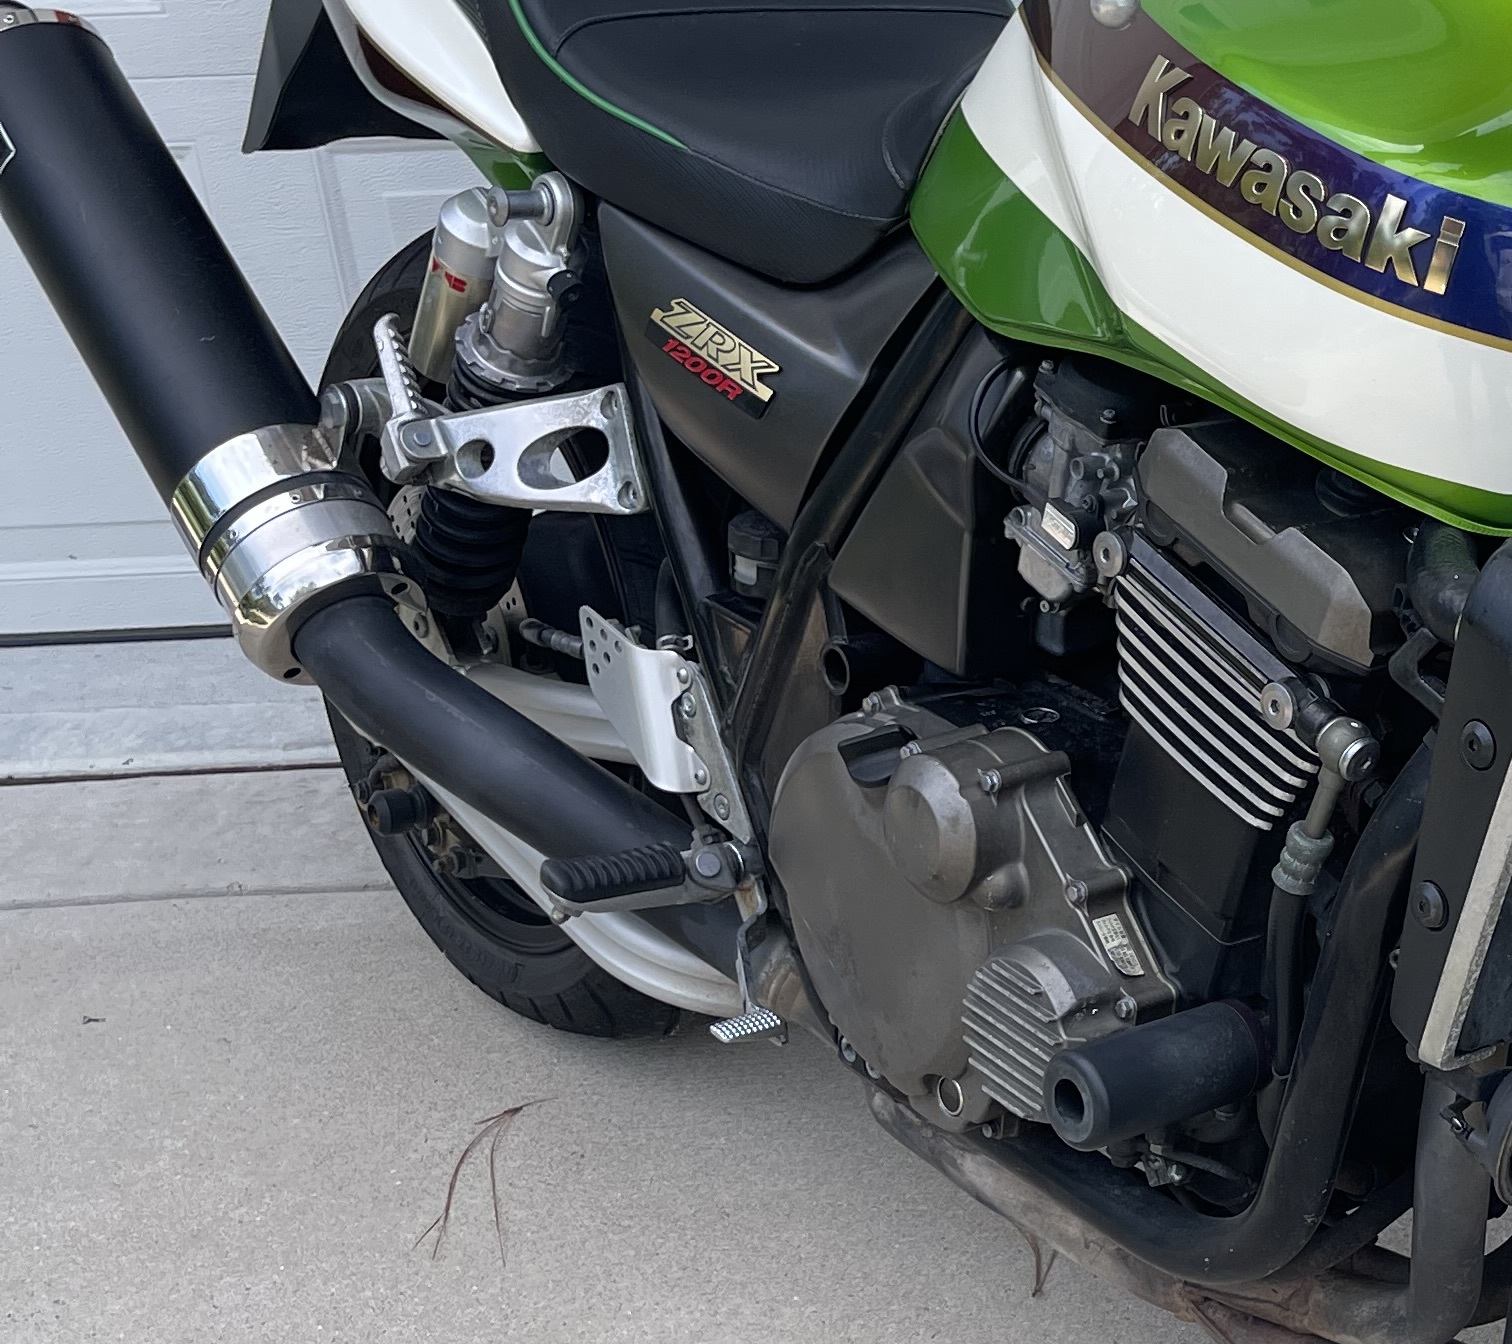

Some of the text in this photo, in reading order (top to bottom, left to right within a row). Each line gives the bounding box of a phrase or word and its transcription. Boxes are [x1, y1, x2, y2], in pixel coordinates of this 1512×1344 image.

[1128, 54, 1466, 295] Kawasaki
[660, 300, 774, 392] ZRX
[661, 338, 744, 401] 1200R
